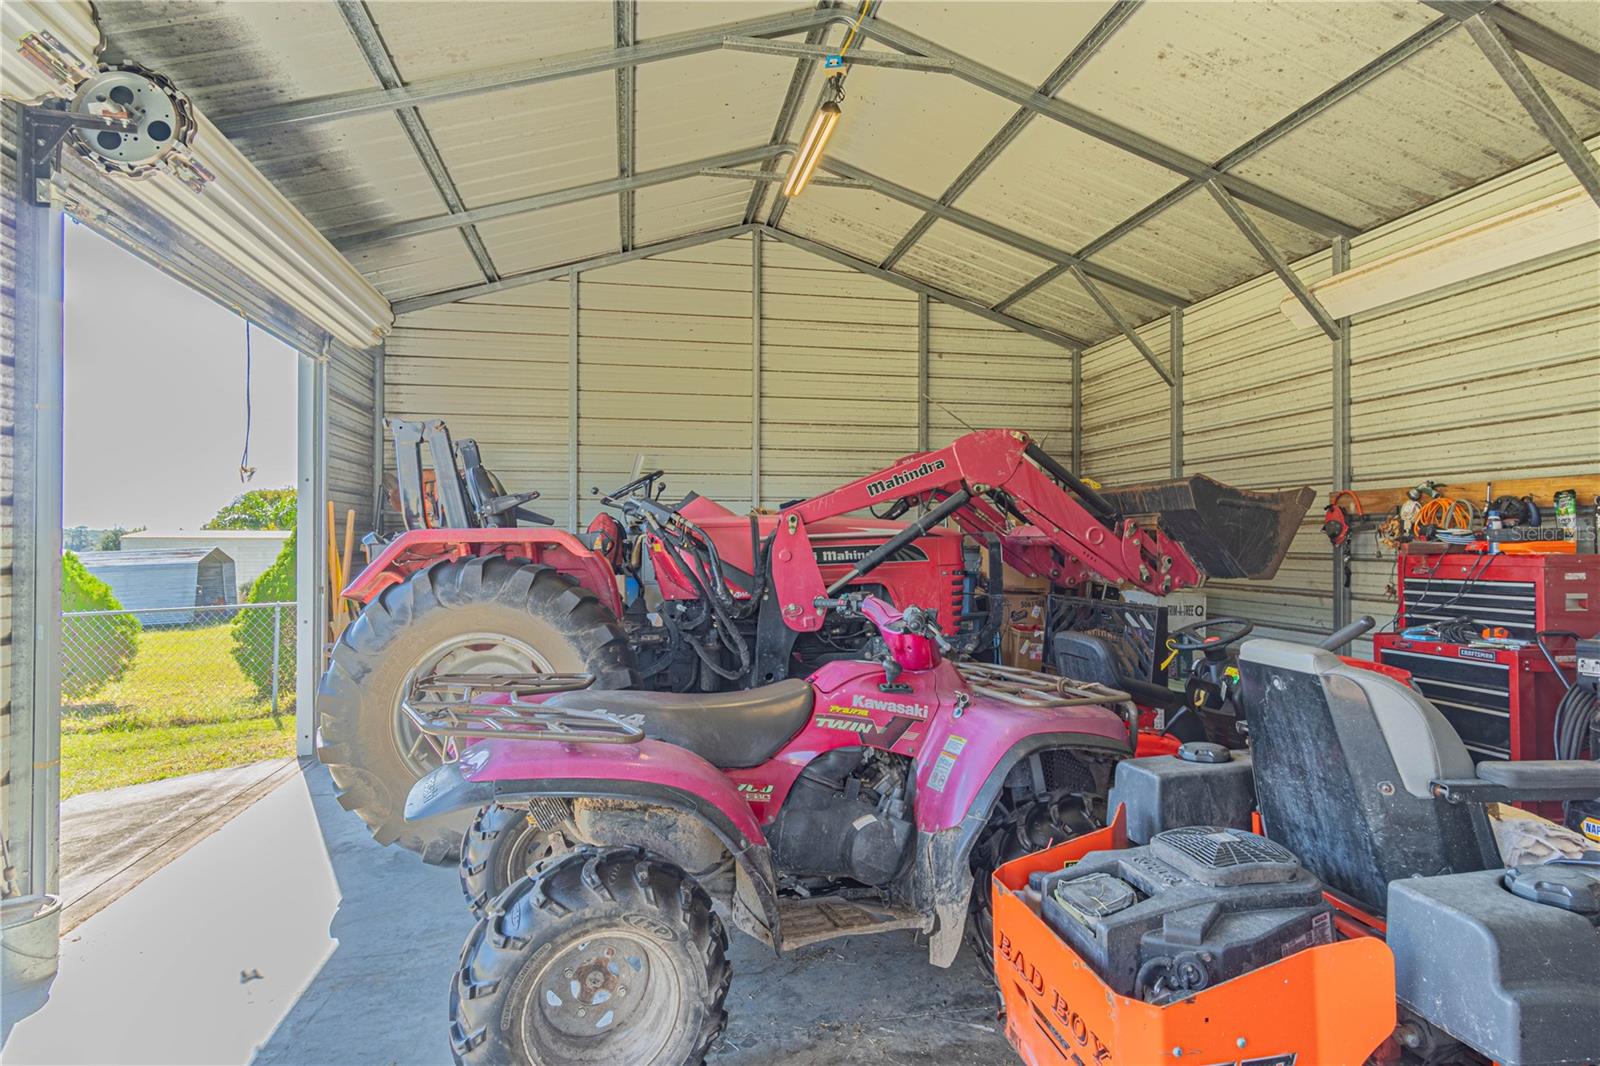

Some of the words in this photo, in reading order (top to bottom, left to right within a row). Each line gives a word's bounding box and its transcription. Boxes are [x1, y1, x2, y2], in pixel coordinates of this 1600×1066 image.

[866, 459, 945, 498] Mahindra
[822, 549, 874, 561] Mahin
[1460, 649, 1494, 660] CRAFTSMAN
[852, 694, 929, 718] Kawasaki
[815, 717, 873, 734] TWIN
[999, 929, 1045, 996] BAD
[1051, 987, 1113, 1066] BOY
